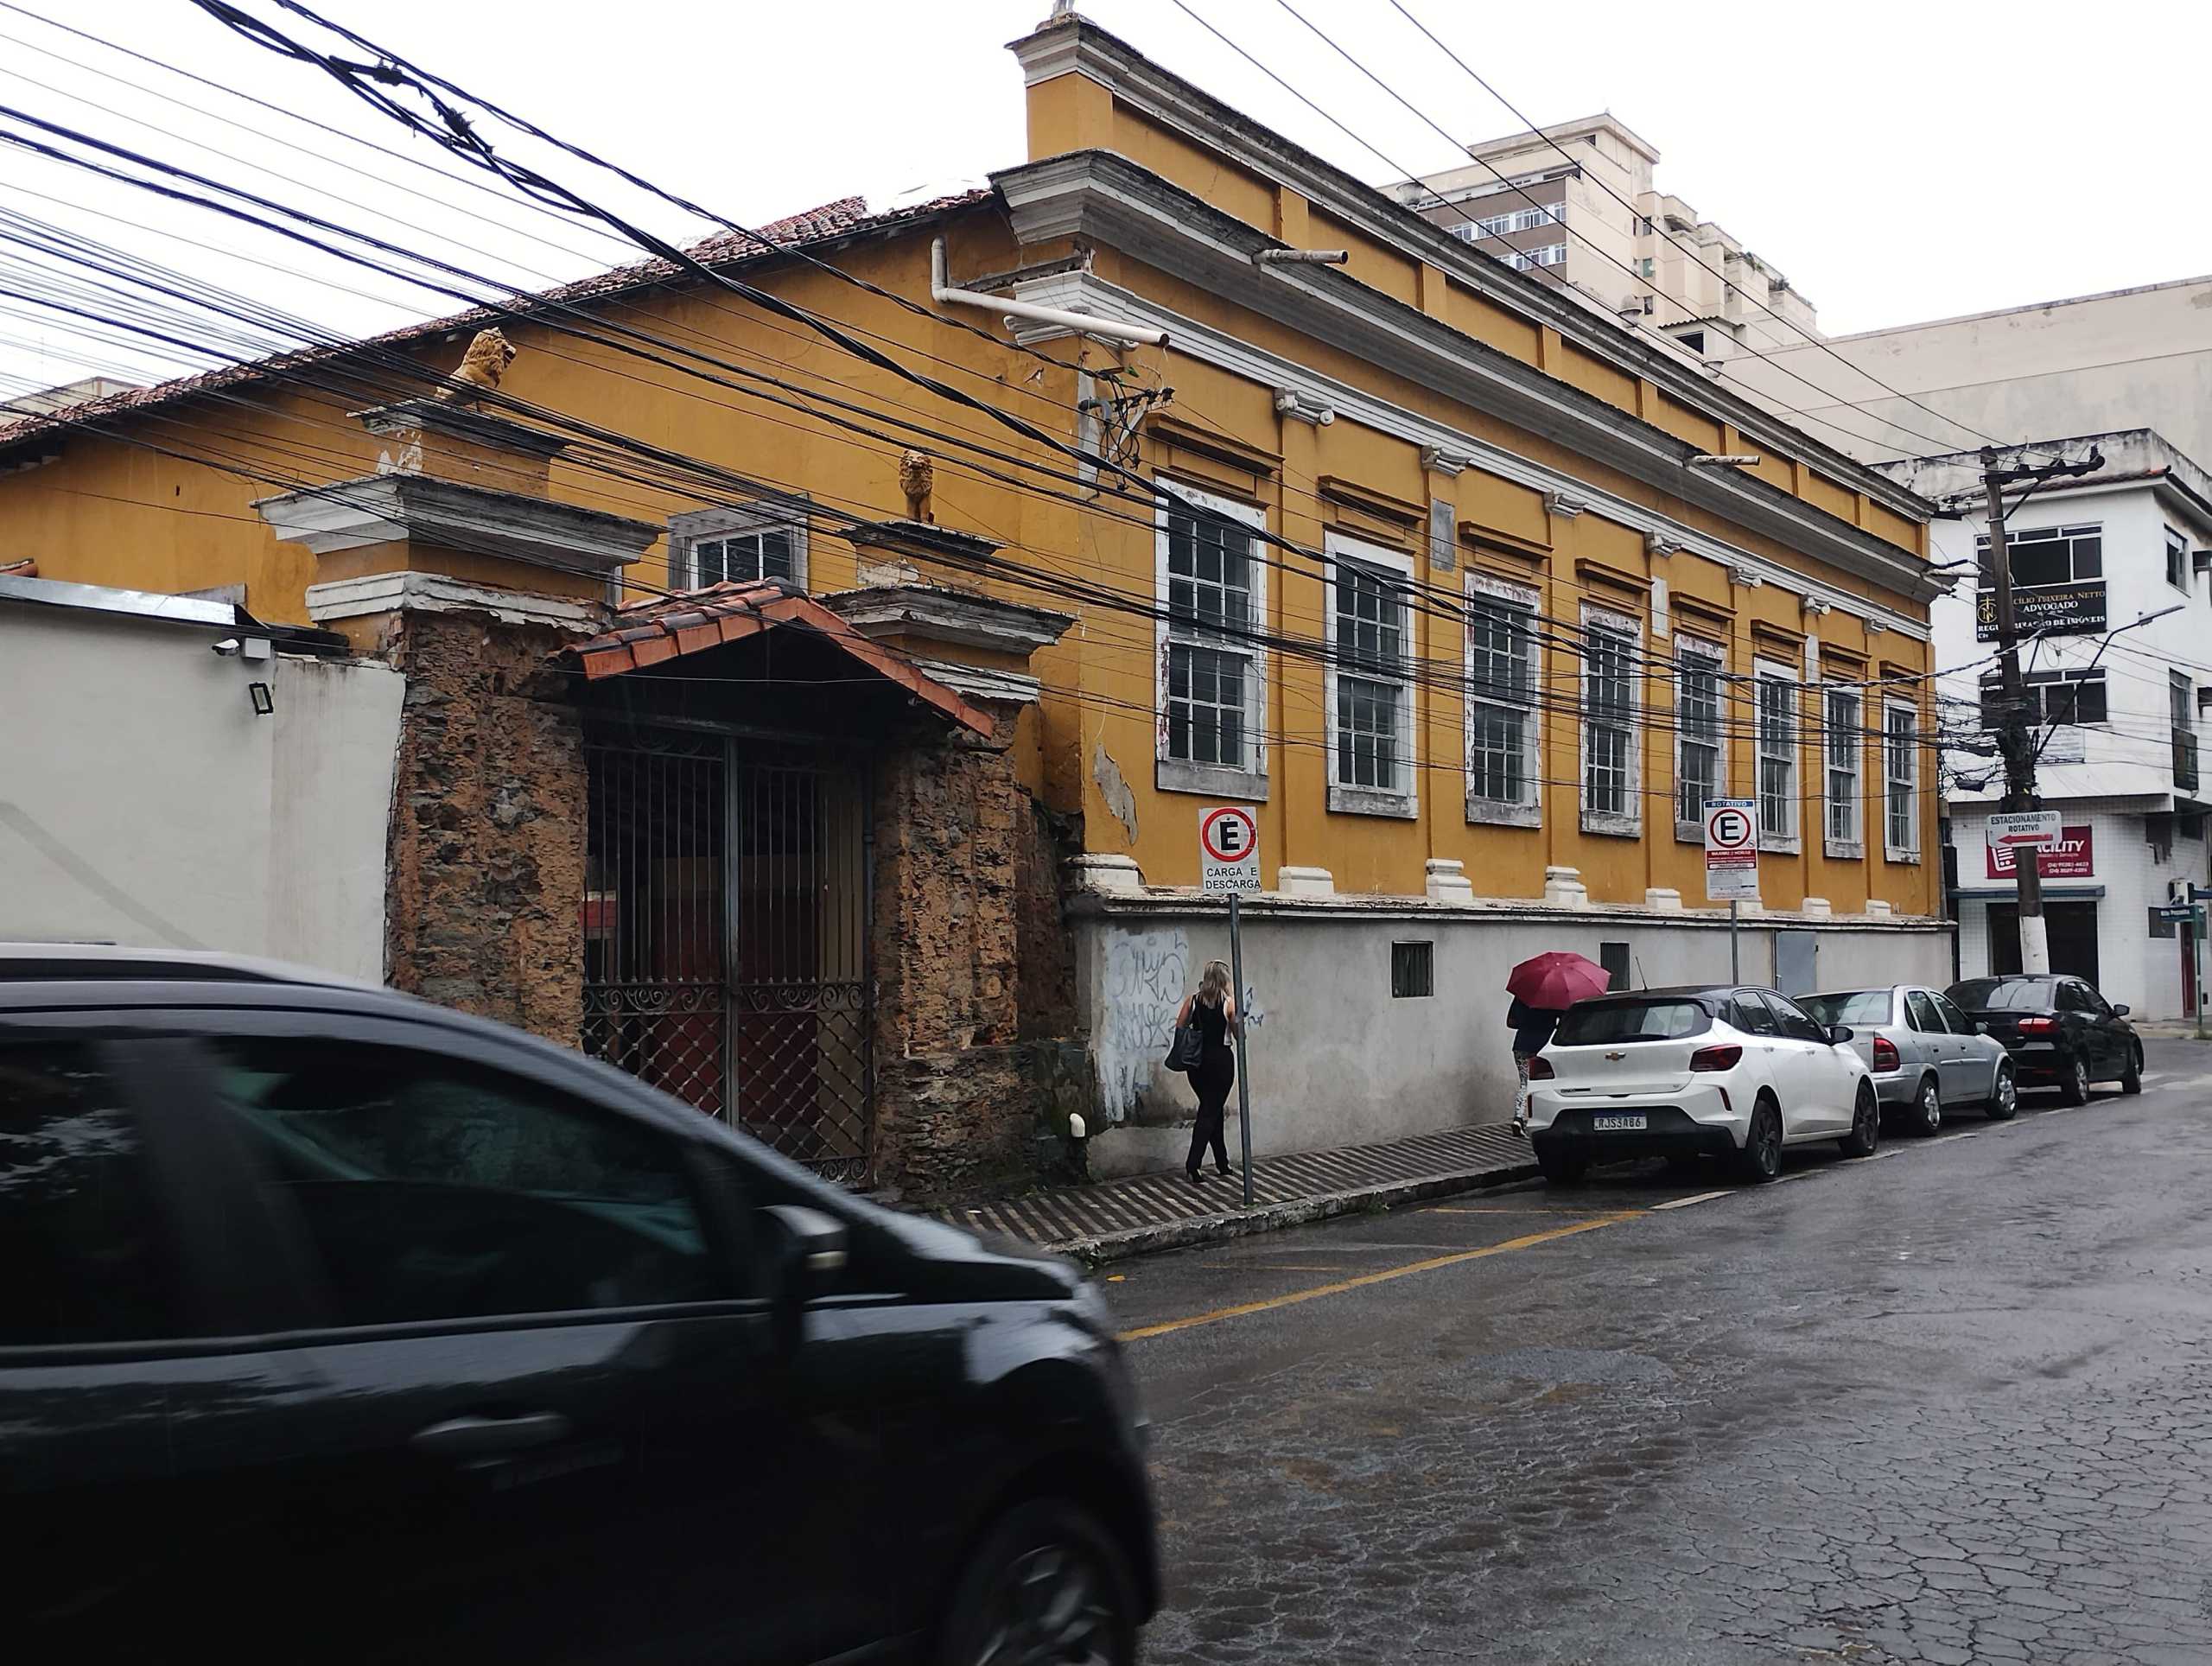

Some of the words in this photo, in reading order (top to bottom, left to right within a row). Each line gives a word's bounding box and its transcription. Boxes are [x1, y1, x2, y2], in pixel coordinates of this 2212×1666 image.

[2078, 590, 2105, 599] NETTO
[2023, 601, 2079, 613] ADVOGADO
[2053, 618, 2066, 626] DE
[1991, 813, 2056, 825] ESTACIONAMENTO
[1719, 816, 1740, 841] E
[2008, 823, 2040, 832] ROTATIVO
[1219, 821, 1241, 850] E
[1206, 867, 1243, 877] CARGA
[1250, 867, 1257, 876] E
[1205, 879, 1261, 889] DESCARGA
